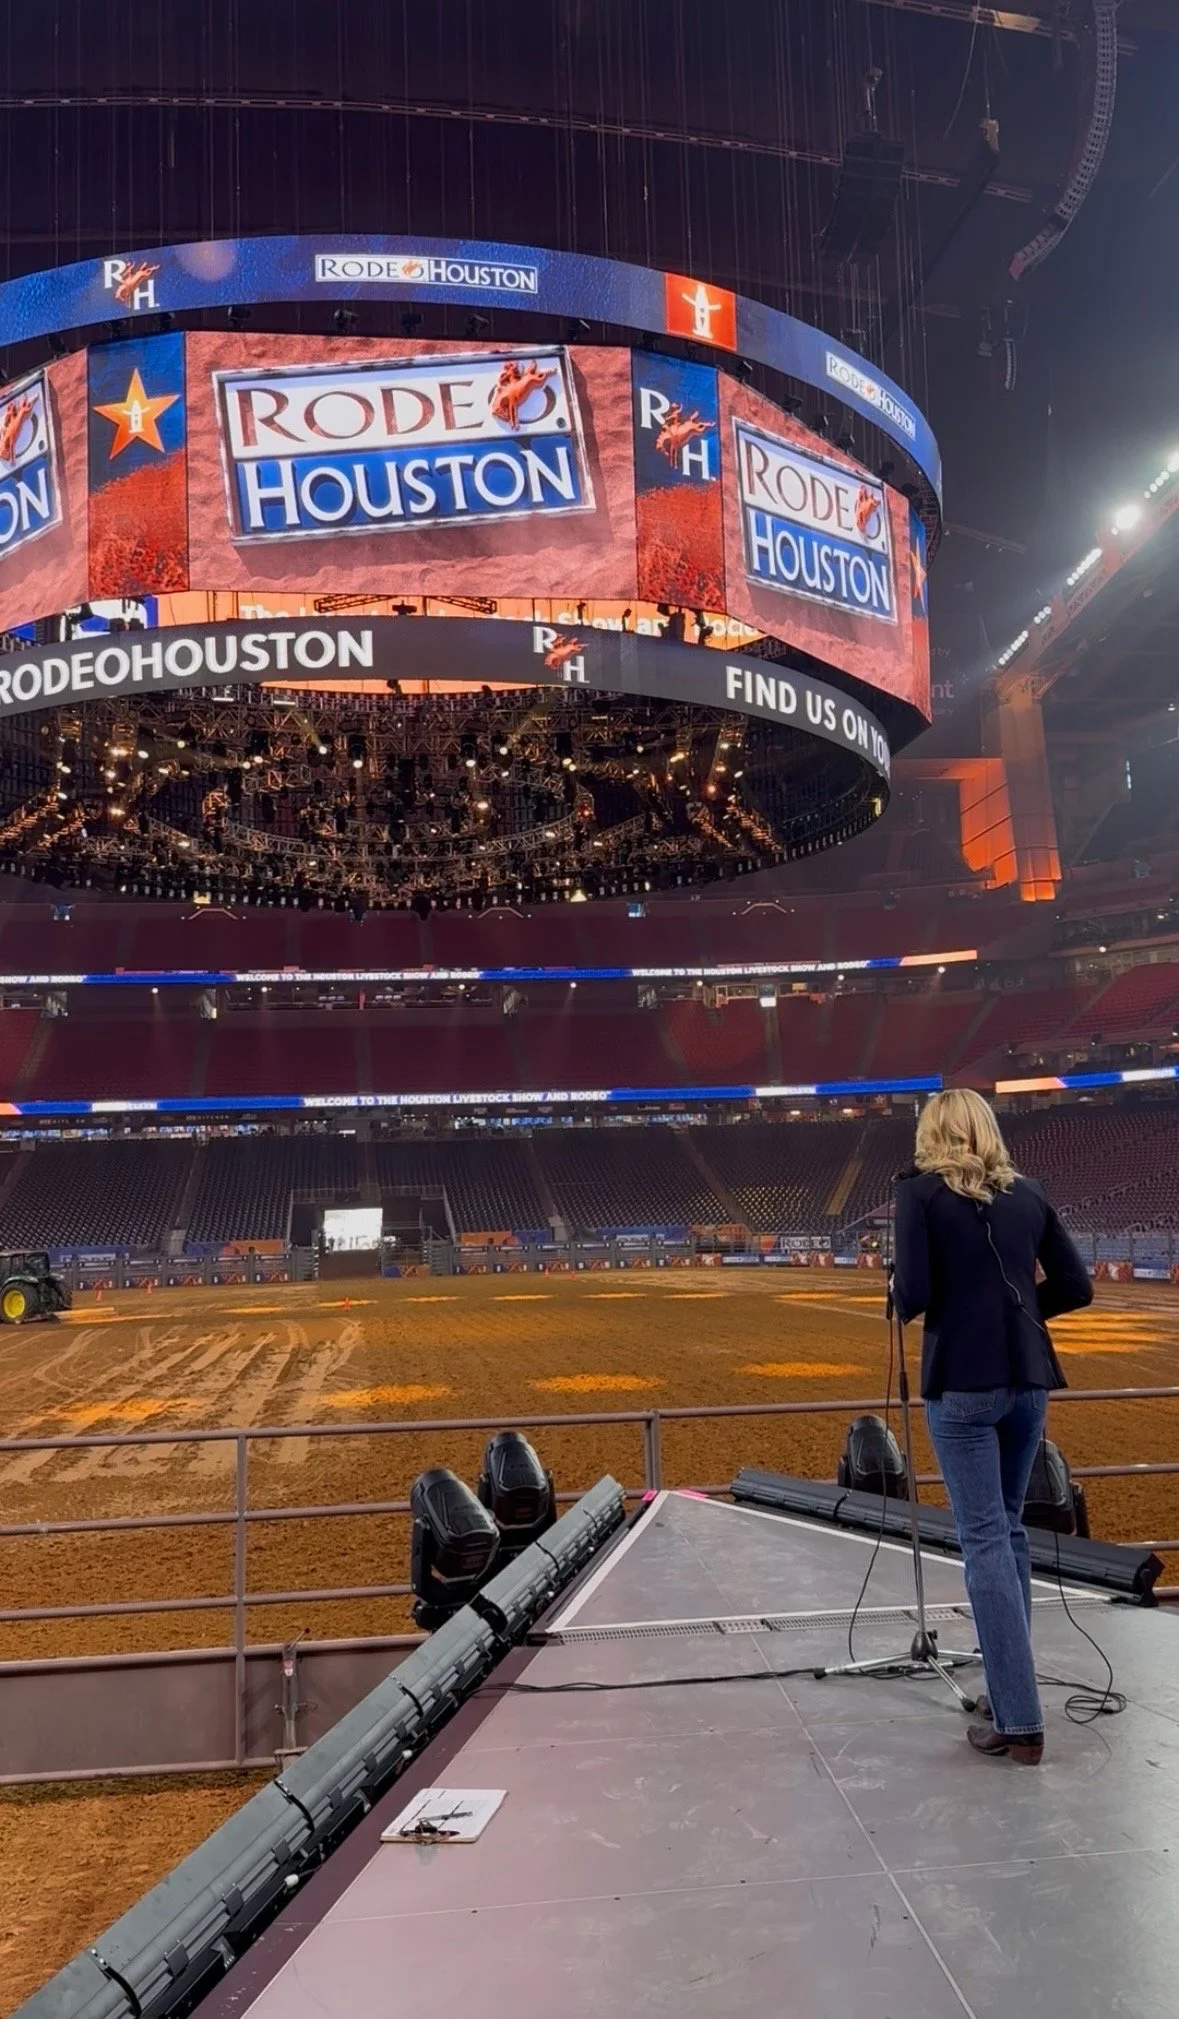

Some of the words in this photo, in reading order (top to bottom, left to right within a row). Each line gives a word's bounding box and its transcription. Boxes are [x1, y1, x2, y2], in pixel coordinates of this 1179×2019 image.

[243, 447, 576, 528] HOUSTON
[749, 510, 891, 610] HOUSTON
[726, 665, 797, 714] FIND
[806, 690, 836, 731] US
[842, 708, 868, 750] ON
[304, 1097, 357, 1106] WELCOME
[360, 1097, 375, 1105] TO
[378, 1096, 398, 1105] THE
[400, 1095, 449, 1104] HOUSTON
[452, 1094, 510, 1103] LIVESTOCK
[511, 1093, 545, 1102] SHOW
[546, 1093, 569, 1101] AND
